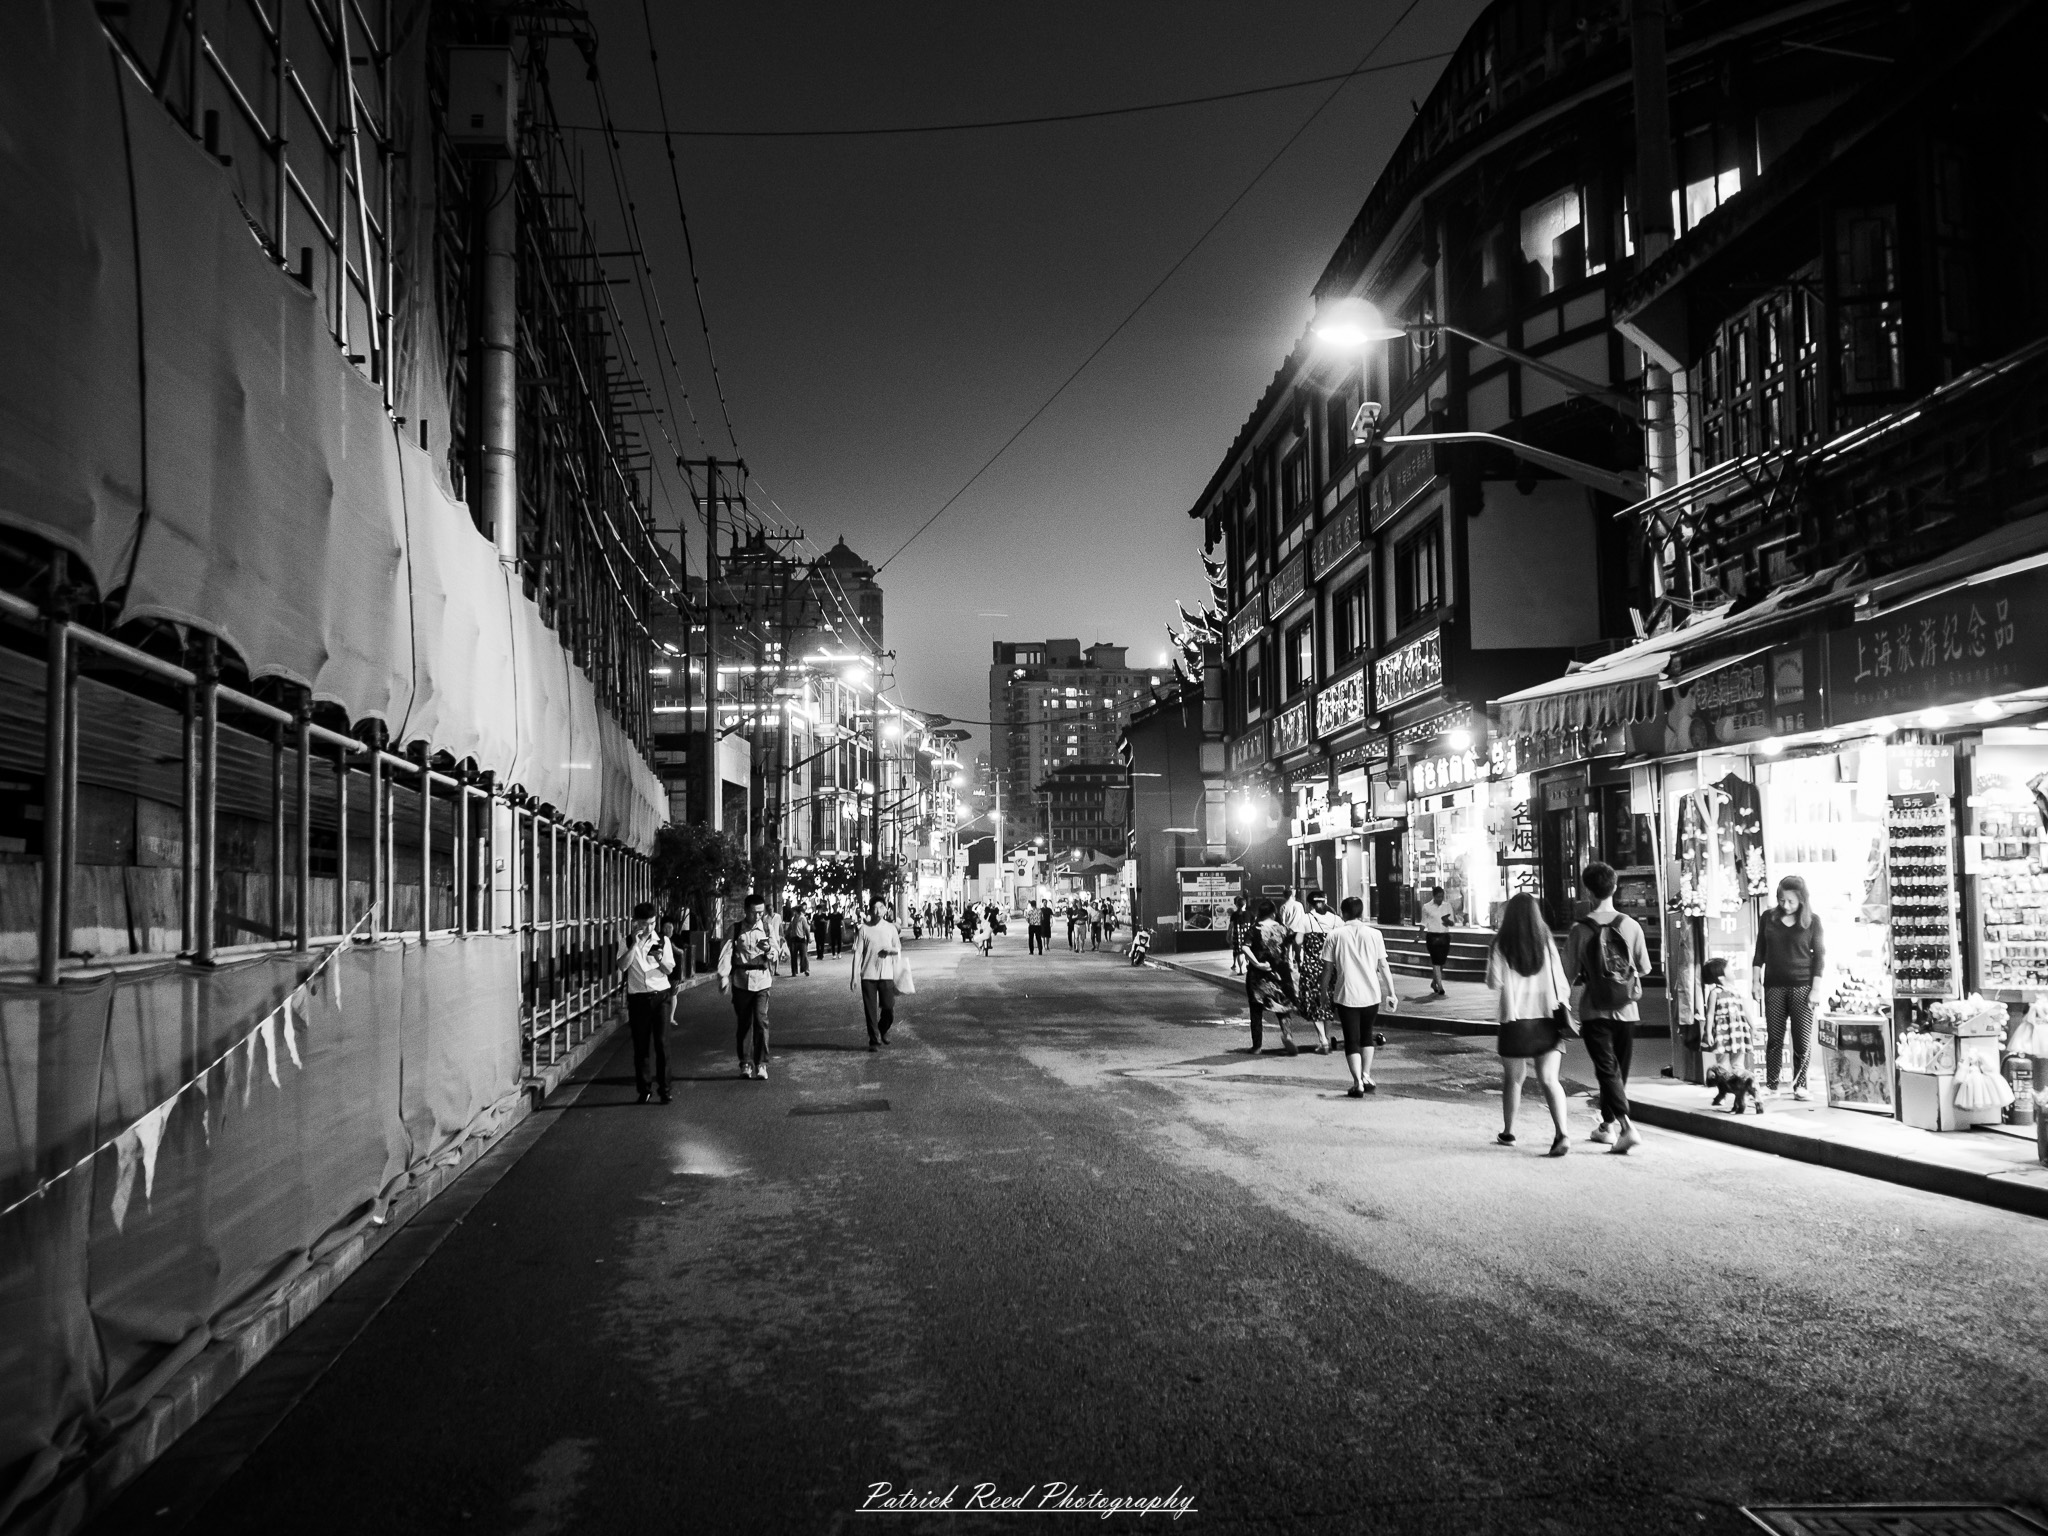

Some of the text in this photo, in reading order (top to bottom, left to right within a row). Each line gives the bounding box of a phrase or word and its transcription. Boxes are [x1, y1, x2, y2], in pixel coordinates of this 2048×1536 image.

[1854, 598, 2014, 683] 上海旅游纪念品
[1902, 797, 1924, 808] 5元
[2018, 813, 2037, 826] 5元
